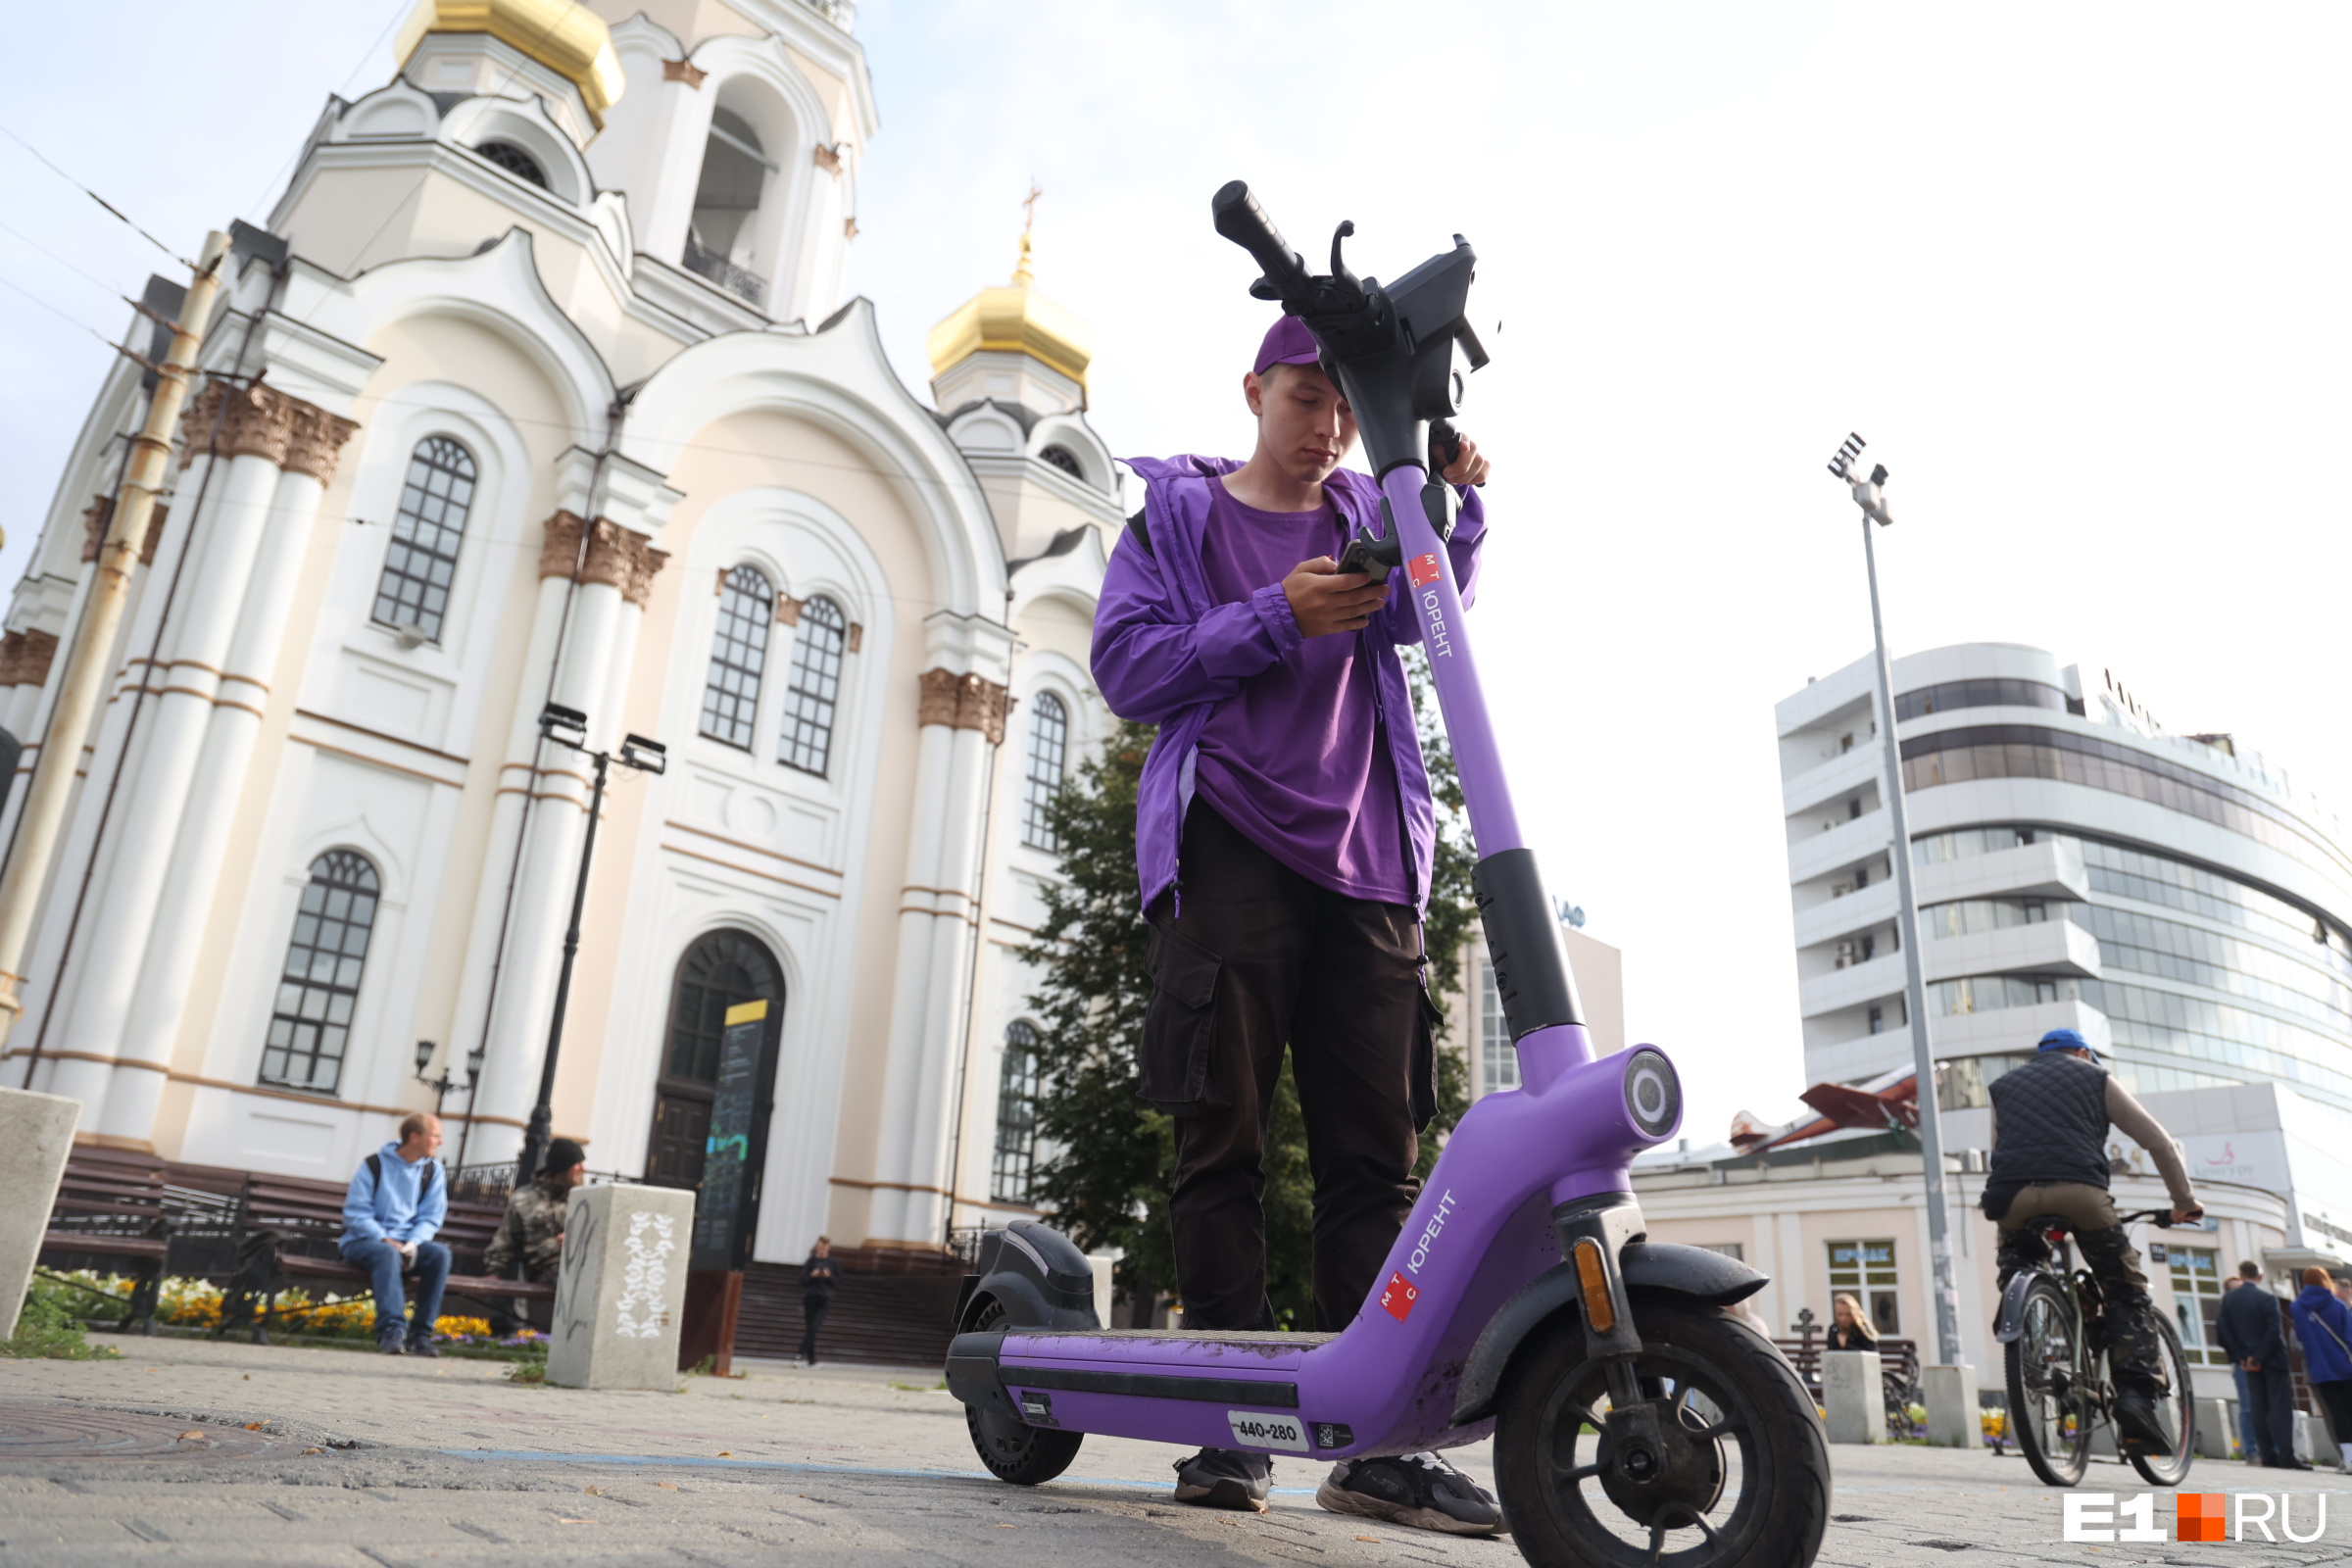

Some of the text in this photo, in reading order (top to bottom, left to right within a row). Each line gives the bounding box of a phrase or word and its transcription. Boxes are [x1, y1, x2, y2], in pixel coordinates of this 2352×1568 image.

[1422, 590, 1452, 657] ЮРЕНТ
[1407, 1190, 1455, 1274] ЮРЕНТ
[1240, 1421, 1297, 1441] 440-280
